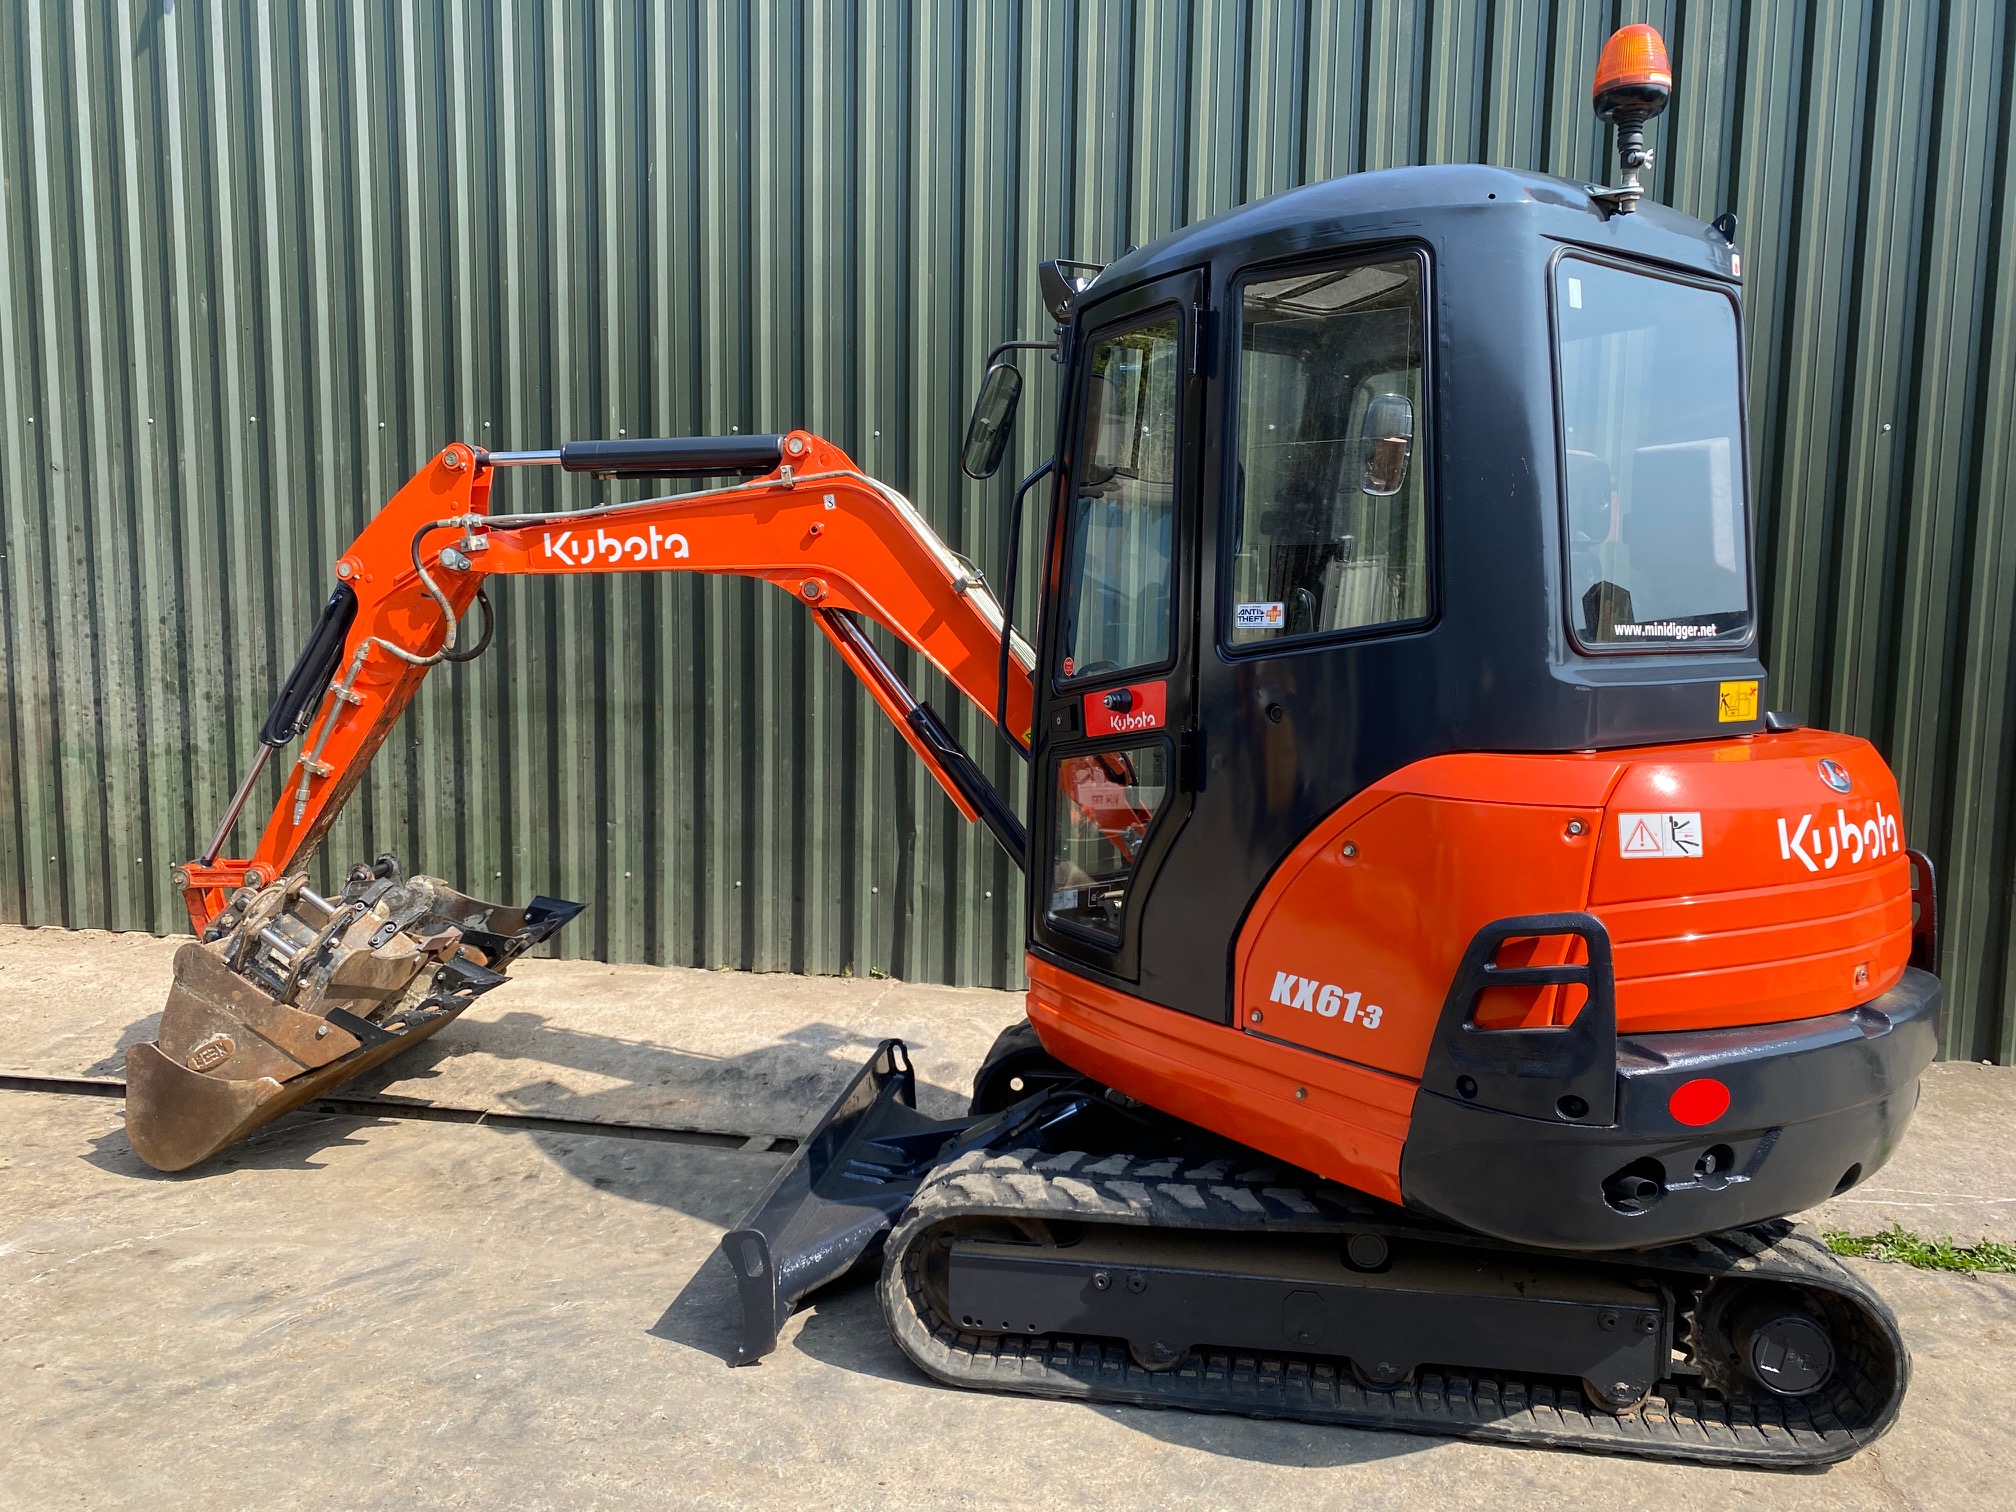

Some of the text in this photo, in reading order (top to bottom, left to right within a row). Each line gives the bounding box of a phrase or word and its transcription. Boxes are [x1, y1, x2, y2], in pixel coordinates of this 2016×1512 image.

[544, 526, 689, 565] Kubota
[1614, 622, 1717, 640] www.minidigger.net
[1110, 711, 1156, 731] Kubota
[1777, 802, 1899, 872] Kubota
[1270, 971, 1383, 1030] KX61-3
